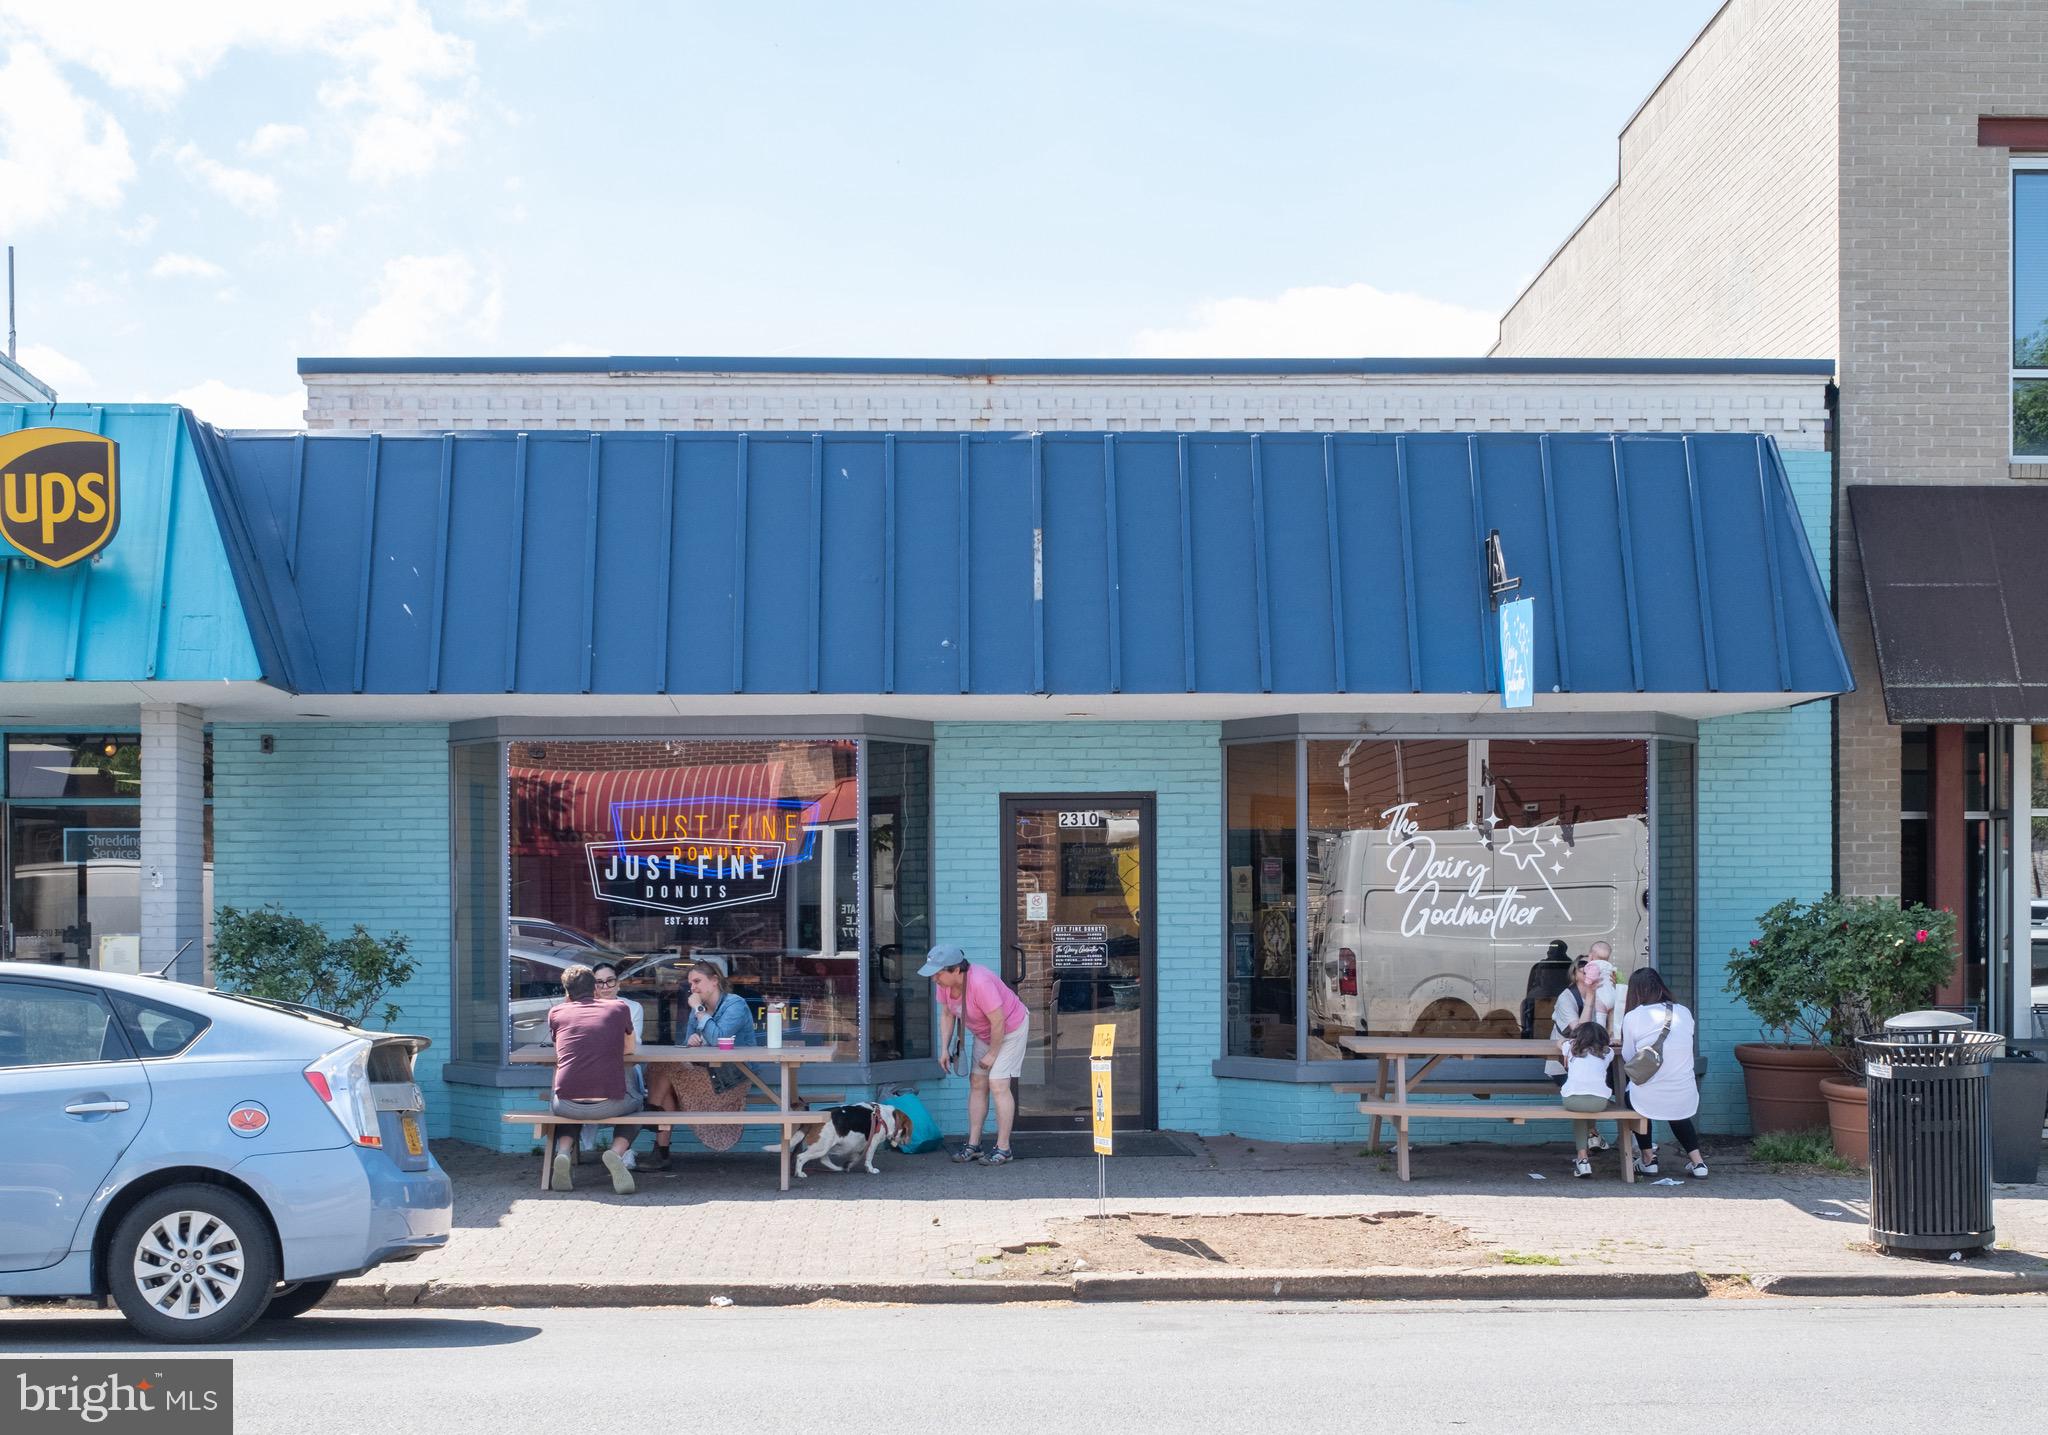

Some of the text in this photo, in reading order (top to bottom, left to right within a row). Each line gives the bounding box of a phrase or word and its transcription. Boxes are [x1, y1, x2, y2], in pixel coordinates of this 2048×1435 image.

[4, 472, 106, 544] ups
[630, 814, 797, 842] JUST FINE
[1060, 813, 1098, 826] 2310
[1380, 802, 1420, 845] The
[92, 848, 140, 859] Services
[673, 846, 759, 861] DONUTS
[605, 855, 765, 881] JUST FINE
[1386, 835, 1490, 898] Dairy
[646, 885, 727, 899] DONUTS
[1400, 880, 1544, 939] Godmother
[665, 916, 709, 926] EST. 2021
[243, 1111, 254, 1122] V
